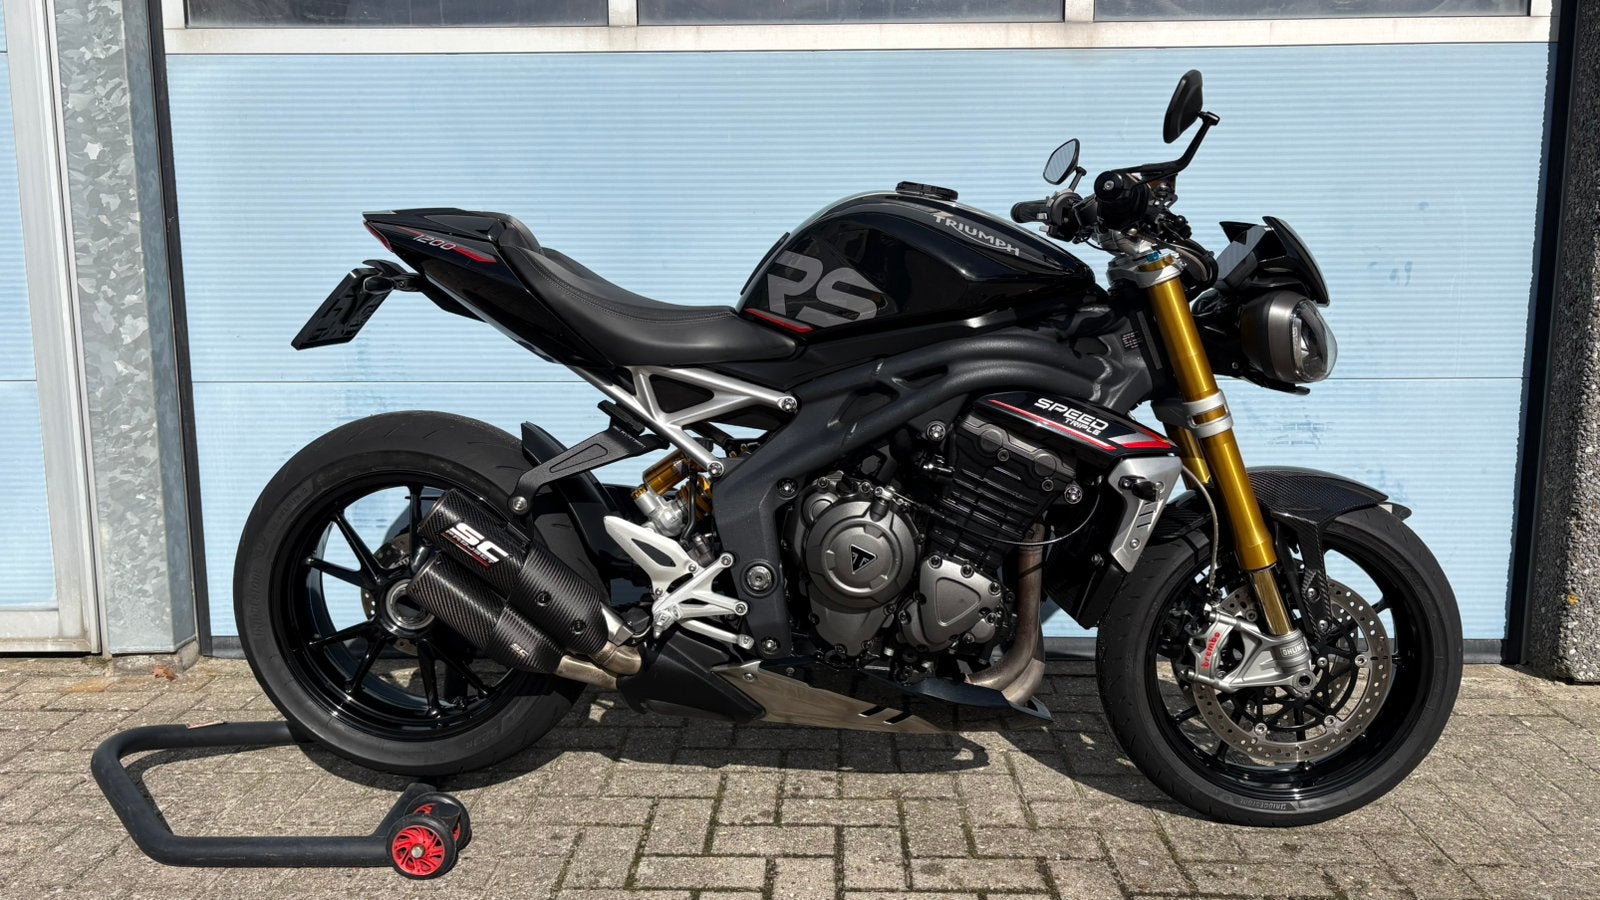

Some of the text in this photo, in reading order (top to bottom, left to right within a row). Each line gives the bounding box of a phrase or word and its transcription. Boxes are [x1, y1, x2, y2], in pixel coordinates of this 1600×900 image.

[413, 234, 457, 250] 1200
[932, 214, 1020, 256] TRIUMPH
[1033, 397, 1109, 431] SPEED
[1065, 417, 1102, 436] TRIPLE
[449, 522, 509, 563] SC
[1201, 631, 1221, 669] brembo
